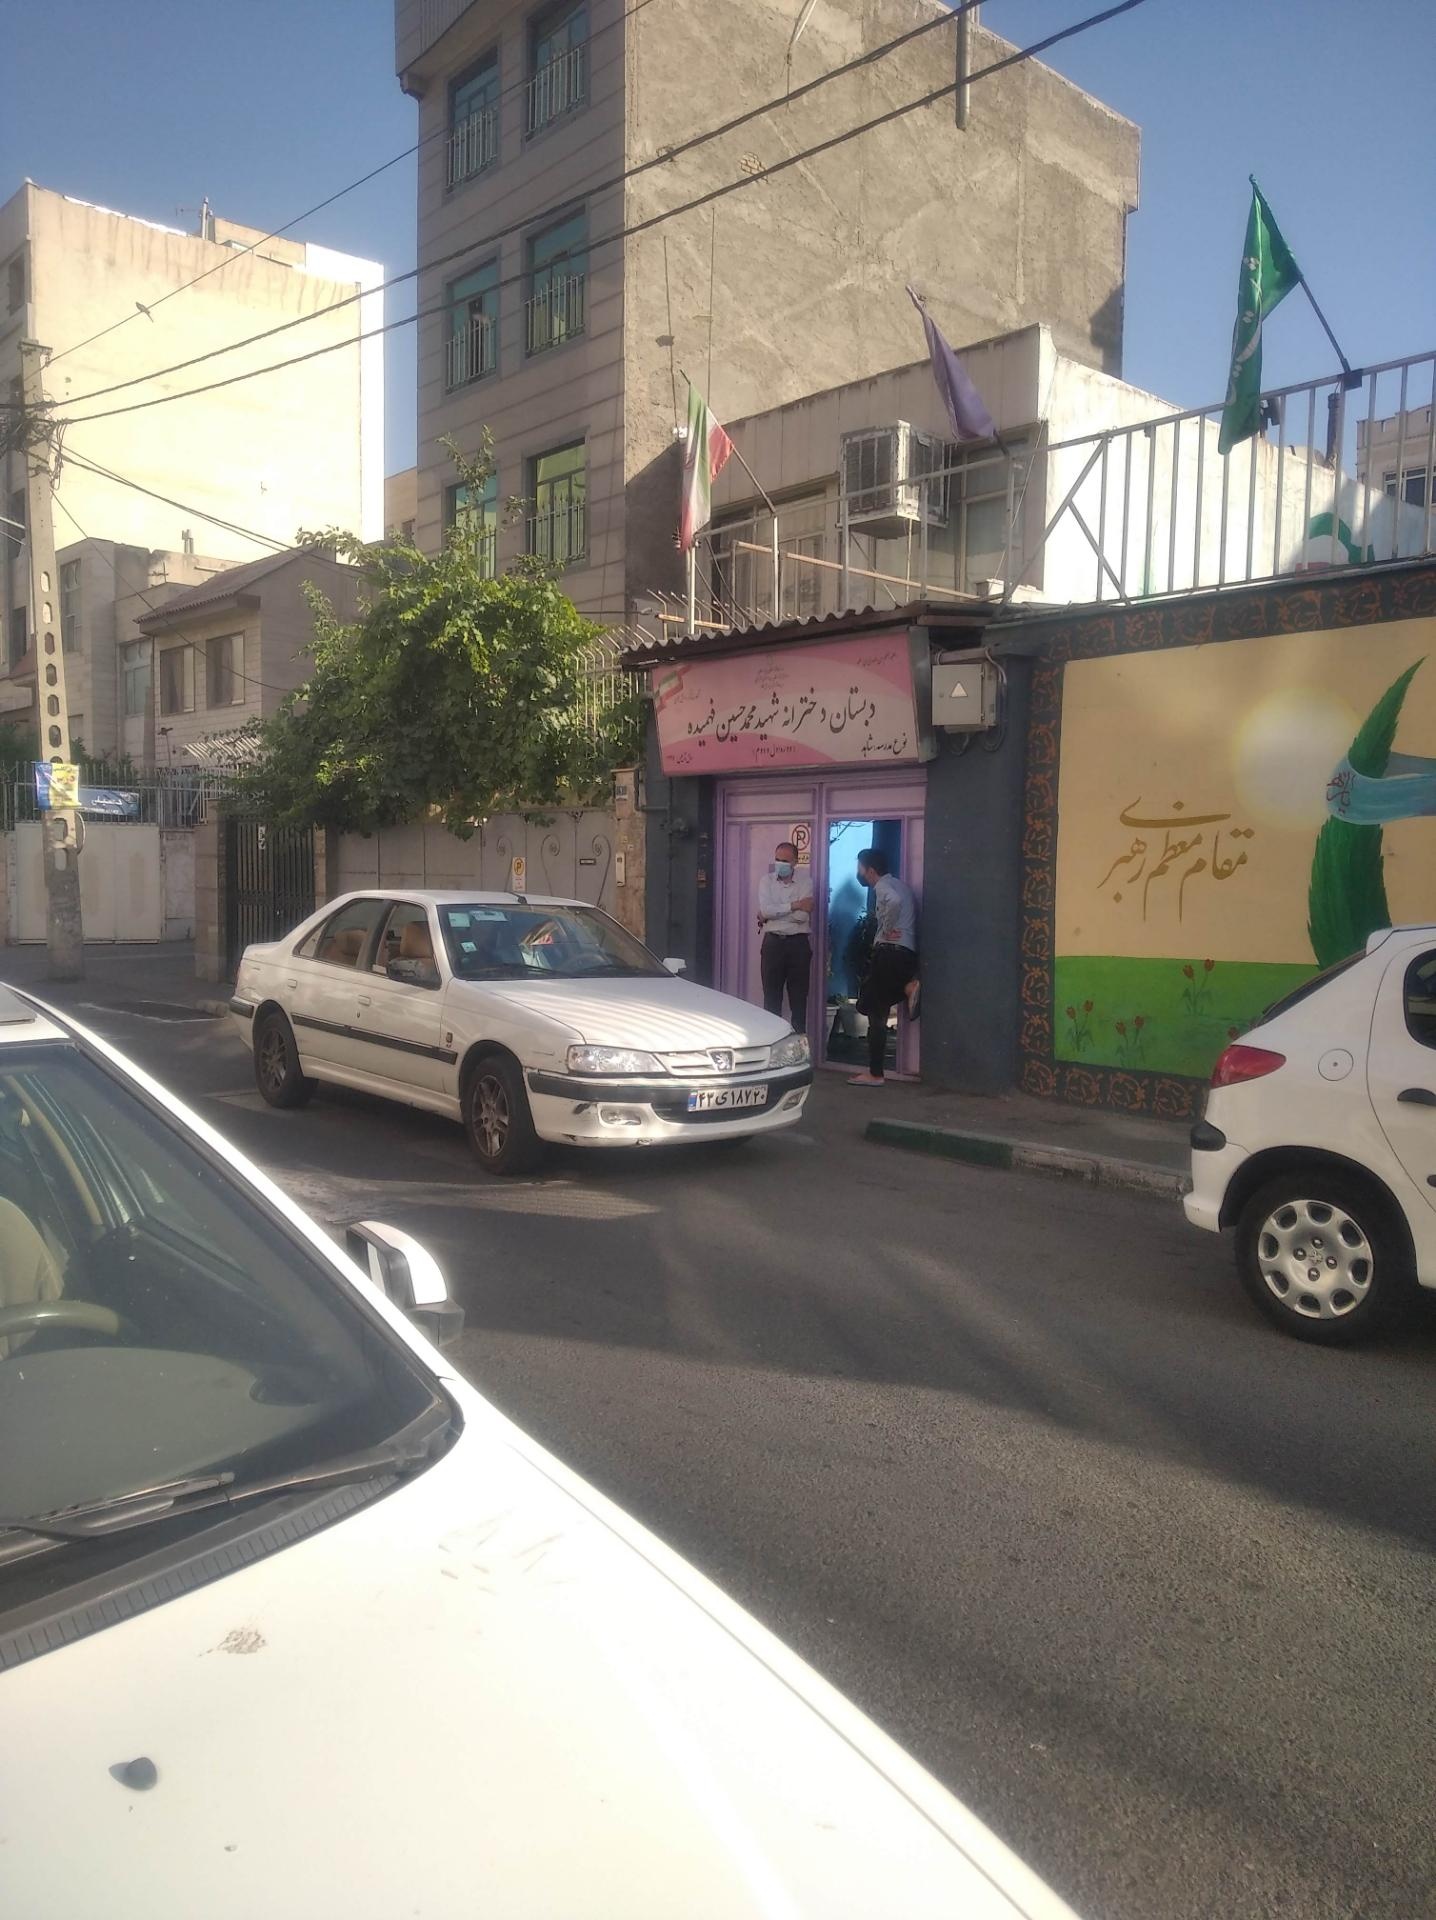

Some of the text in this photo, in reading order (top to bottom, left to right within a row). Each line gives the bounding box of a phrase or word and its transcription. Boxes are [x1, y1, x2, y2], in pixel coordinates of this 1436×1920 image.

[687, 698, 716, 747] فهمیده
[754, 691, 780, 741] شهید
[782, 687, 826, 733] دخترانه
[829, 686, 876, 734] دبستان
[893, 732, 907, 755] نوع
[1143, 800, 1204, 923] معظم
[1179, 828, 1255, 927] مقام
